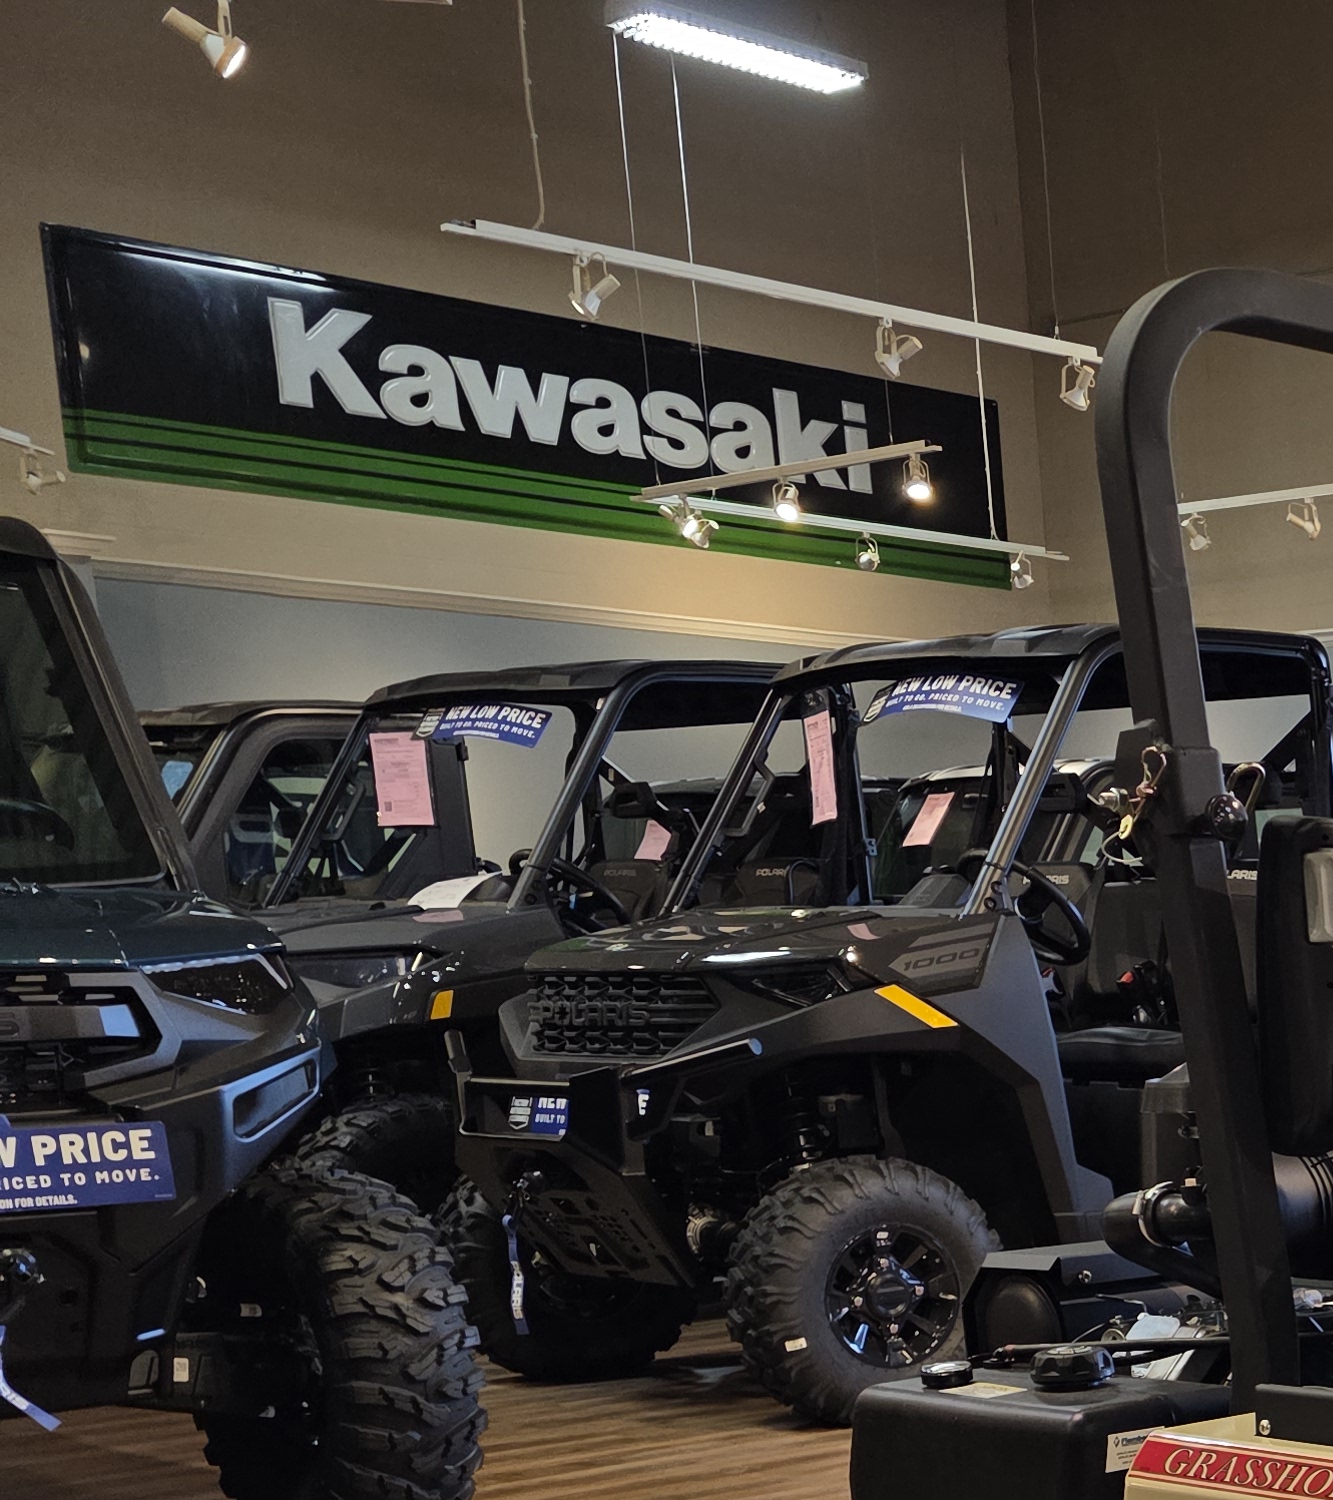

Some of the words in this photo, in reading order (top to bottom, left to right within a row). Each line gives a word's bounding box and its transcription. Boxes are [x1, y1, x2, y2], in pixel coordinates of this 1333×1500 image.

[266, 296, 872, 495] Kawasaki
[892, 676, 925, 697] NEW
[922, 674, 960, 691] LOW
[957, 675, 1017, 700] PRICE
[928, 693, 960, 702] PRICED
[962, 696, 974, 705] TO
[976, 698, 1005, 711] MOVE.
[446, 706, 470, 720] NEW
[470, 705, 498, 719] LOW
[498, 706, 547, 729] PRICE
[474, 721, 499, 731] PRICED
[500, 724, 509, 732] TO
[511, 726, 536, 739] MOVE.
[903, 948, 980, 971] 1000
[541, 997, 648, 1026] POLARIS
[535, 1113, 554, 1123] BUILT
[556, 1113, 565, 1123] TO
[31, 1129, 156, 1167] PRICE
[0, 1174, 52, 1191] ICED
[60, 1173, 86, 1187] TO
[95, 1168, 160, 1184] MOVE.
[15, 1197, 35, 1209] FOR
[36, 1193, 78, 1207] DETAILS.
